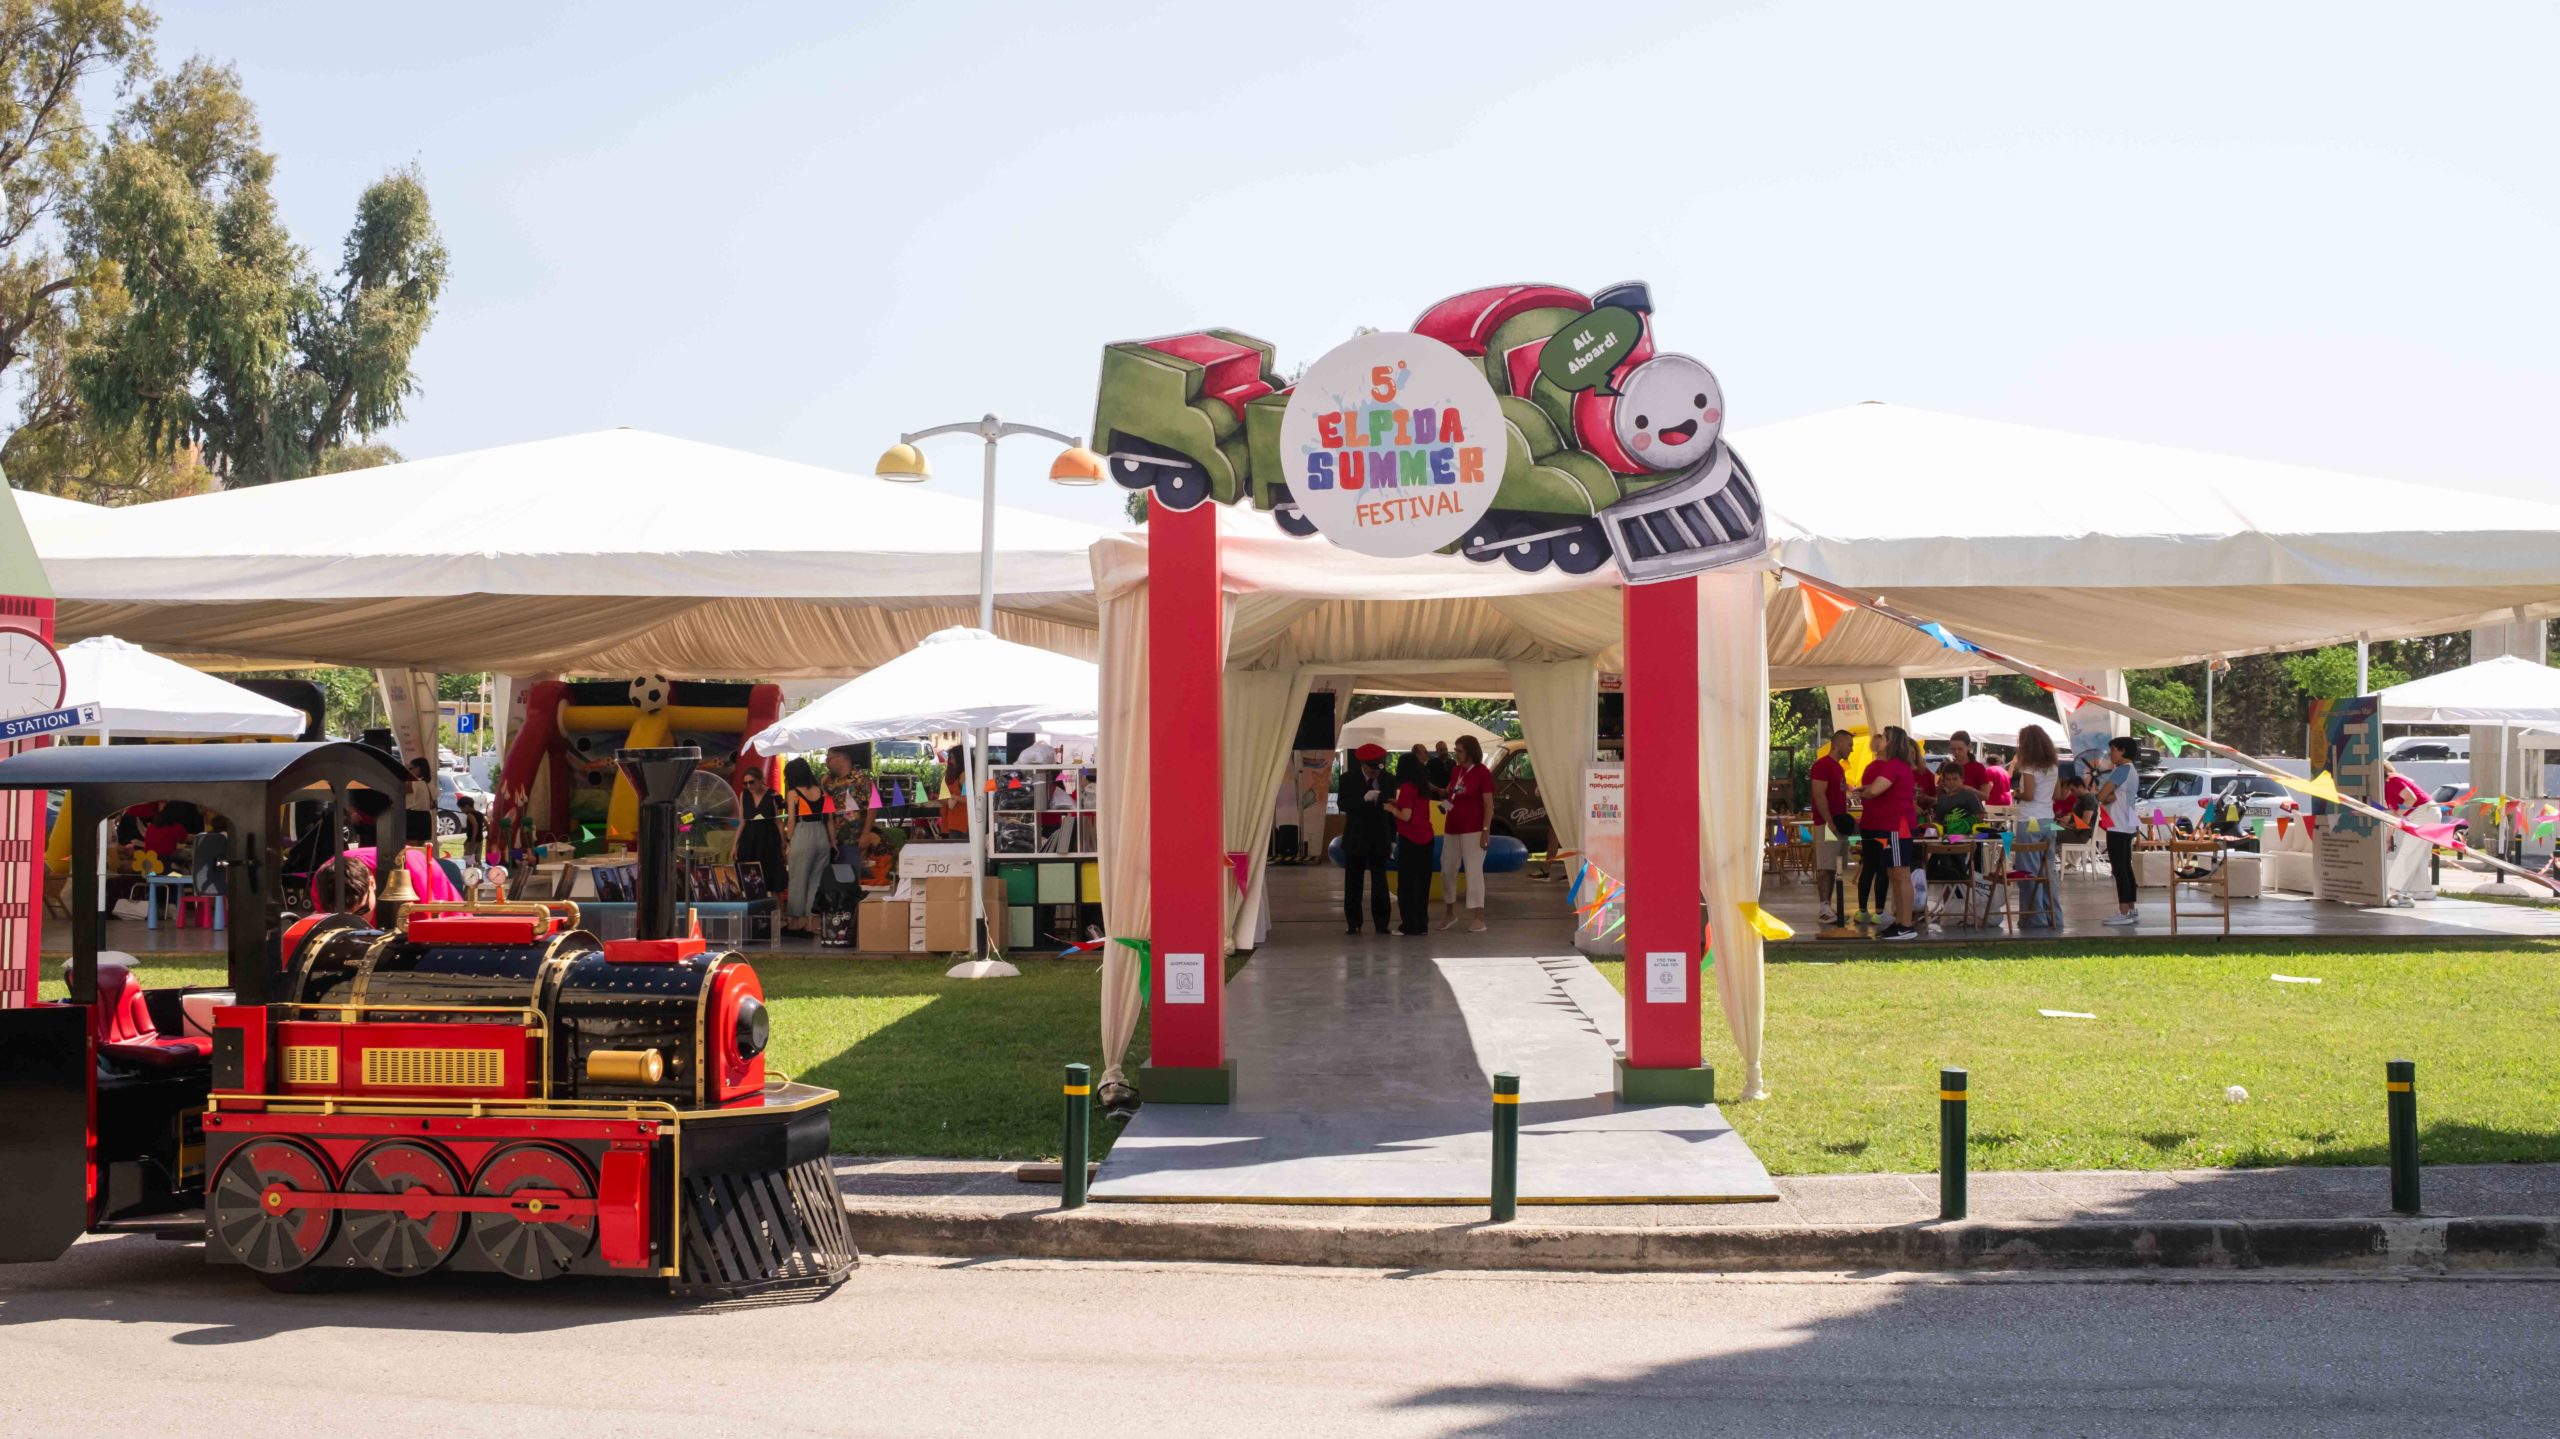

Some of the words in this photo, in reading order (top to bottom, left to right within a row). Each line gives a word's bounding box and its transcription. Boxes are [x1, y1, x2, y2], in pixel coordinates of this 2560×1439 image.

[1568, 331, 1618, 374] Aboard!
[1573, 329, 1595, 351] All
[1318, 407, 1465, 449] ELPIDA
[1307, 447, 1485, 490] SUMMER
[1356, 491, 1464, 528] FESTIVAL
[6, 713, 69, 735] STATION
[461, 716, 470, 732] P
